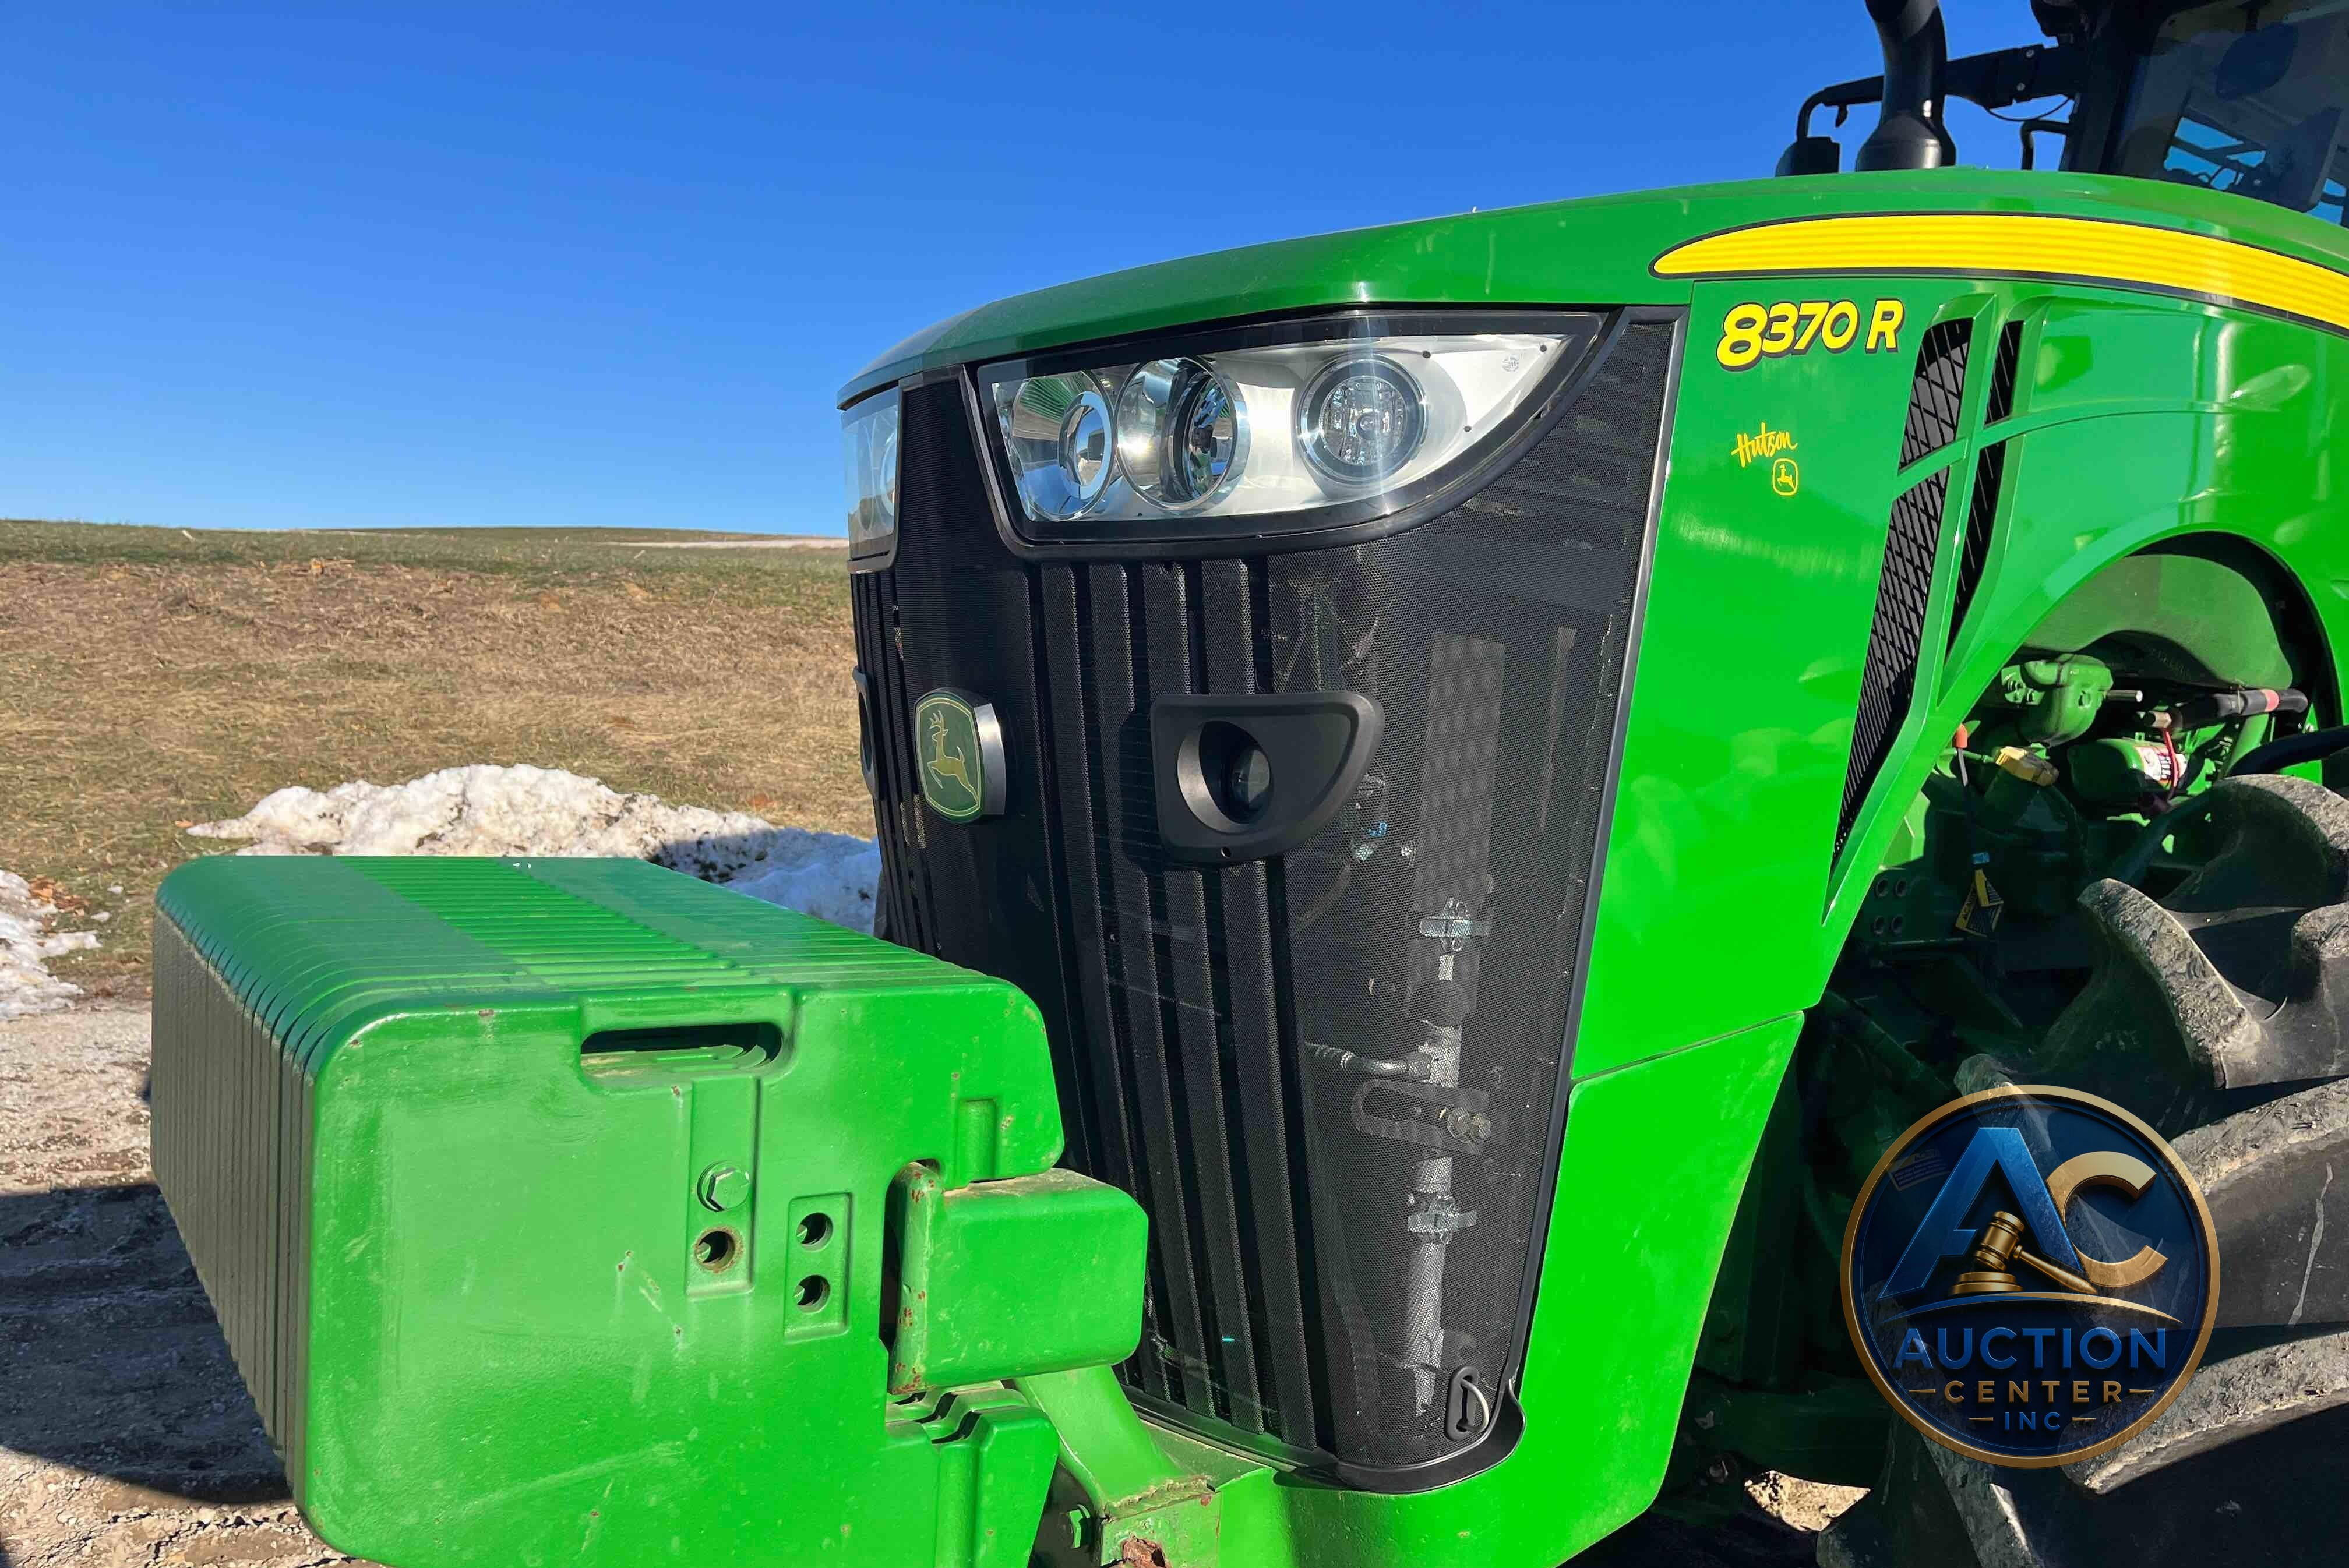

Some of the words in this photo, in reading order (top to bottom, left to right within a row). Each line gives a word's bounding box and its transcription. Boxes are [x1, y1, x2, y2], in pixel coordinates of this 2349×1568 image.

[1716, 299, 1860, 372] 8370
[1865, 298, 1905, 354] R
[1731, 422, 1798, 467] Hutson
